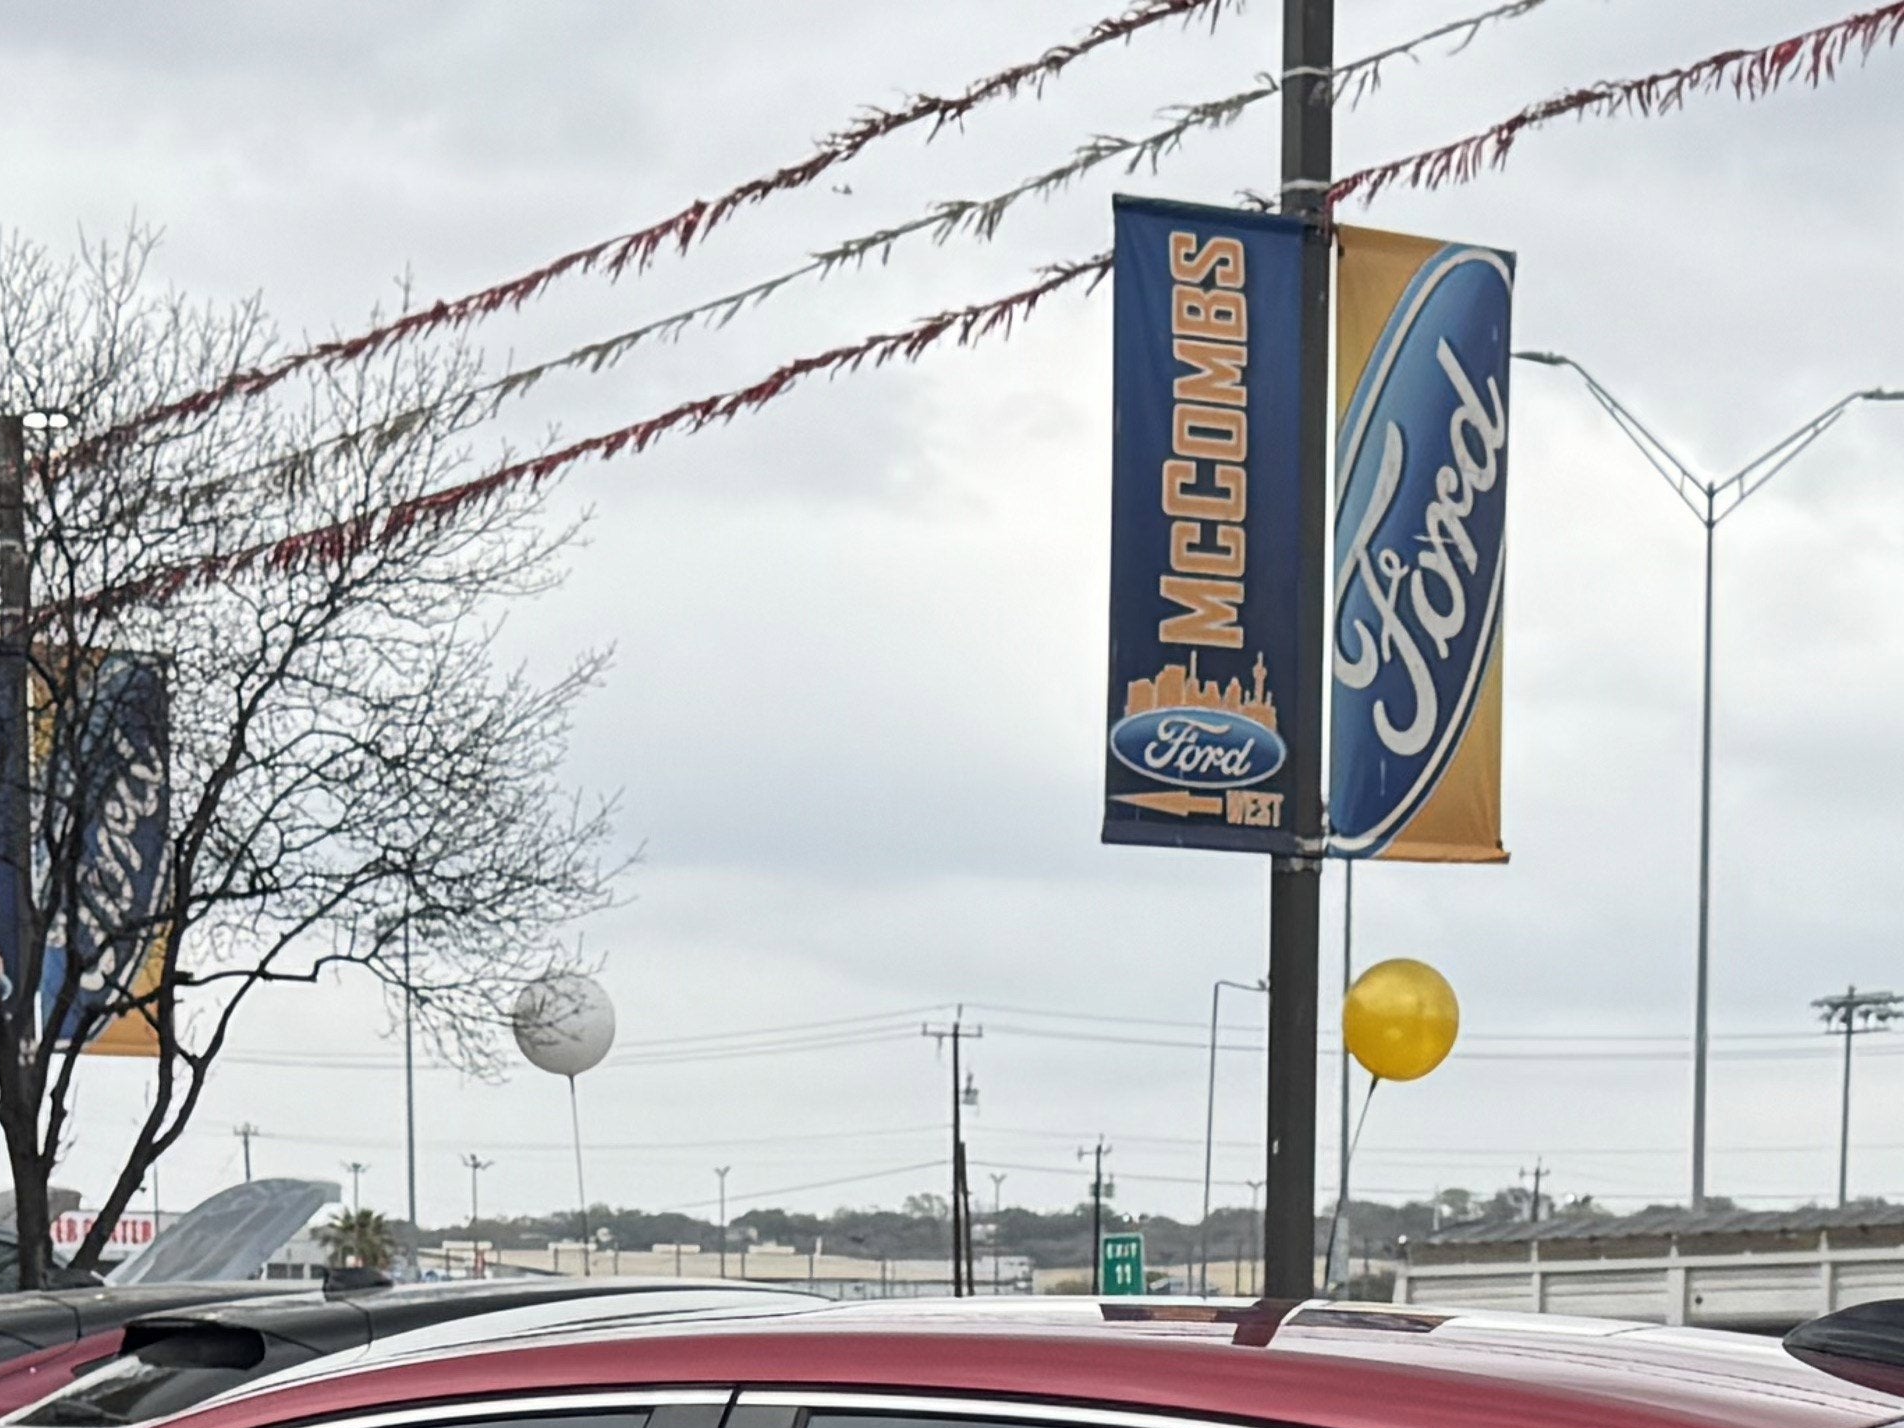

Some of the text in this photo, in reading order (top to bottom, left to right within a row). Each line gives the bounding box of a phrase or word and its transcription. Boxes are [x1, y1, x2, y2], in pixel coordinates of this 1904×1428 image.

[1158, 230, 1248, 650] MCCOMBS
[1333, 336, 1506, 757] Ford
[1144, 715, 1255, 777] Ford
[1225, 790, 1284, 828] WEST
[1107, 1242, 1137, 1260] EXIT
